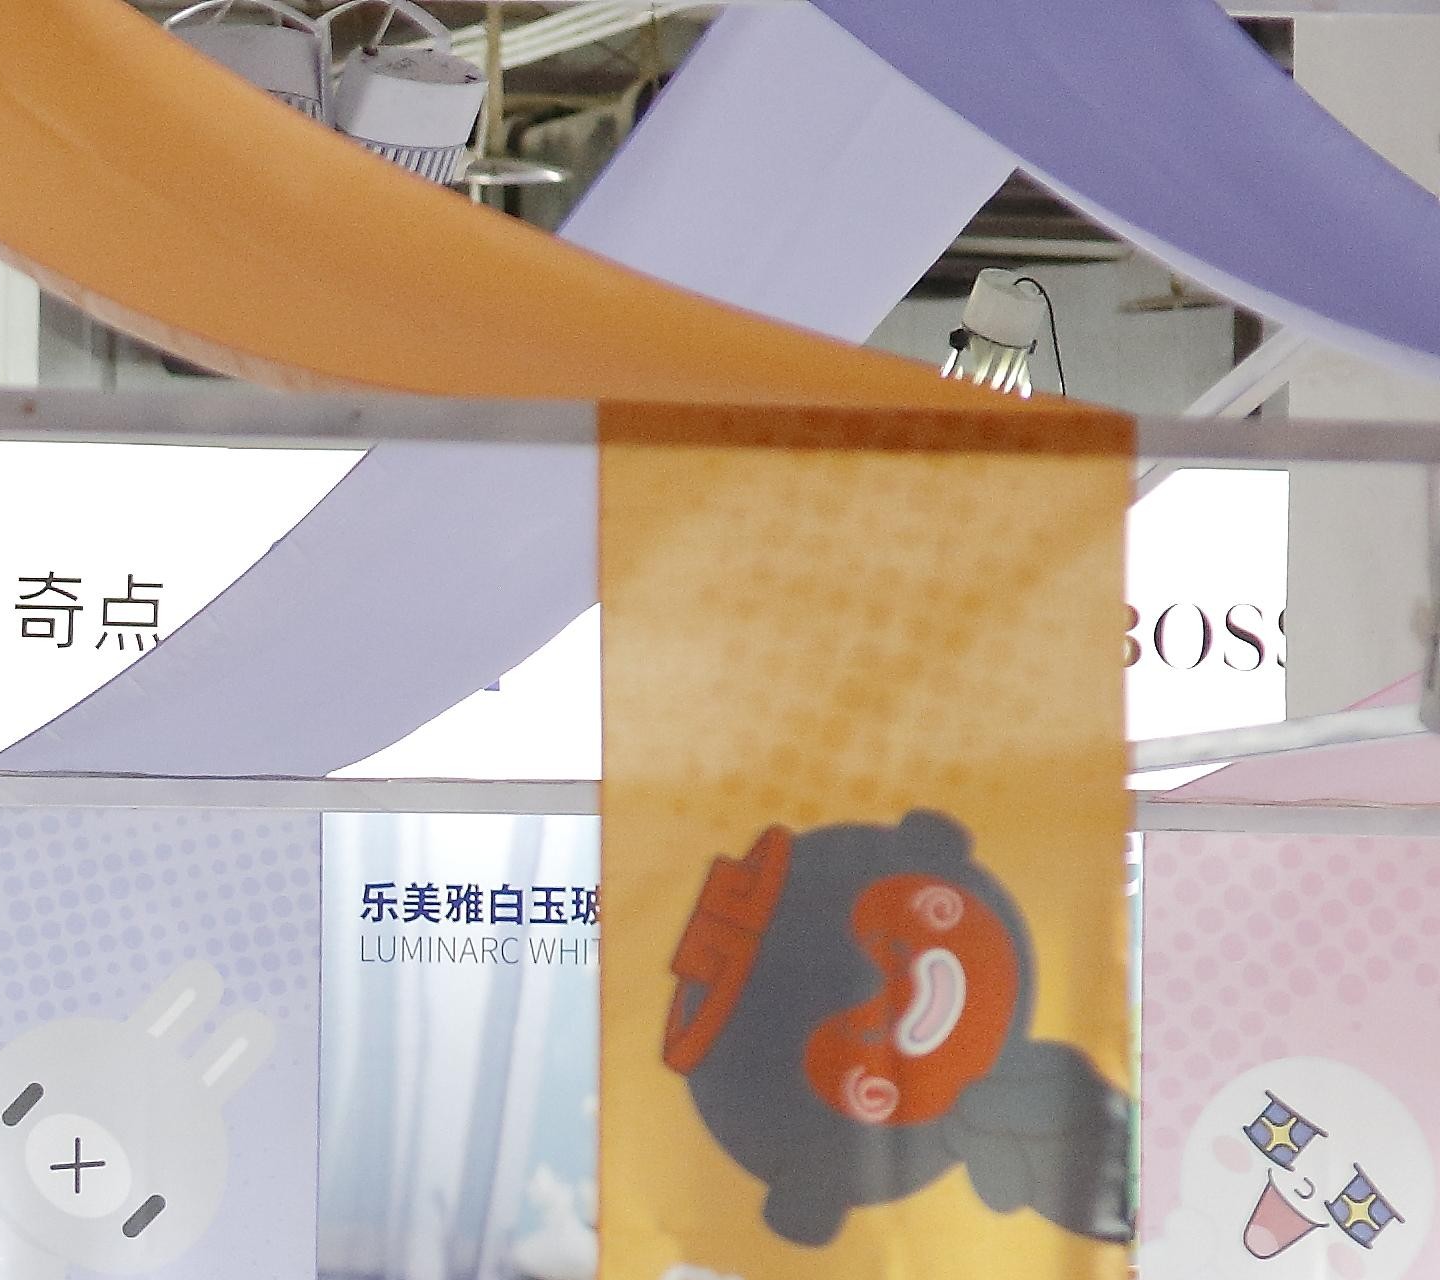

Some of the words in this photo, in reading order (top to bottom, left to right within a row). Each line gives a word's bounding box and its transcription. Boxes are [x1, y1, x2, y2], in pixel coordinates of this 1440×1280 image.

[15, 571, 165, 650] 奇点
[360, 936, 520, 965] LUMINARC
[529, 936, 600, 965] WHIT
